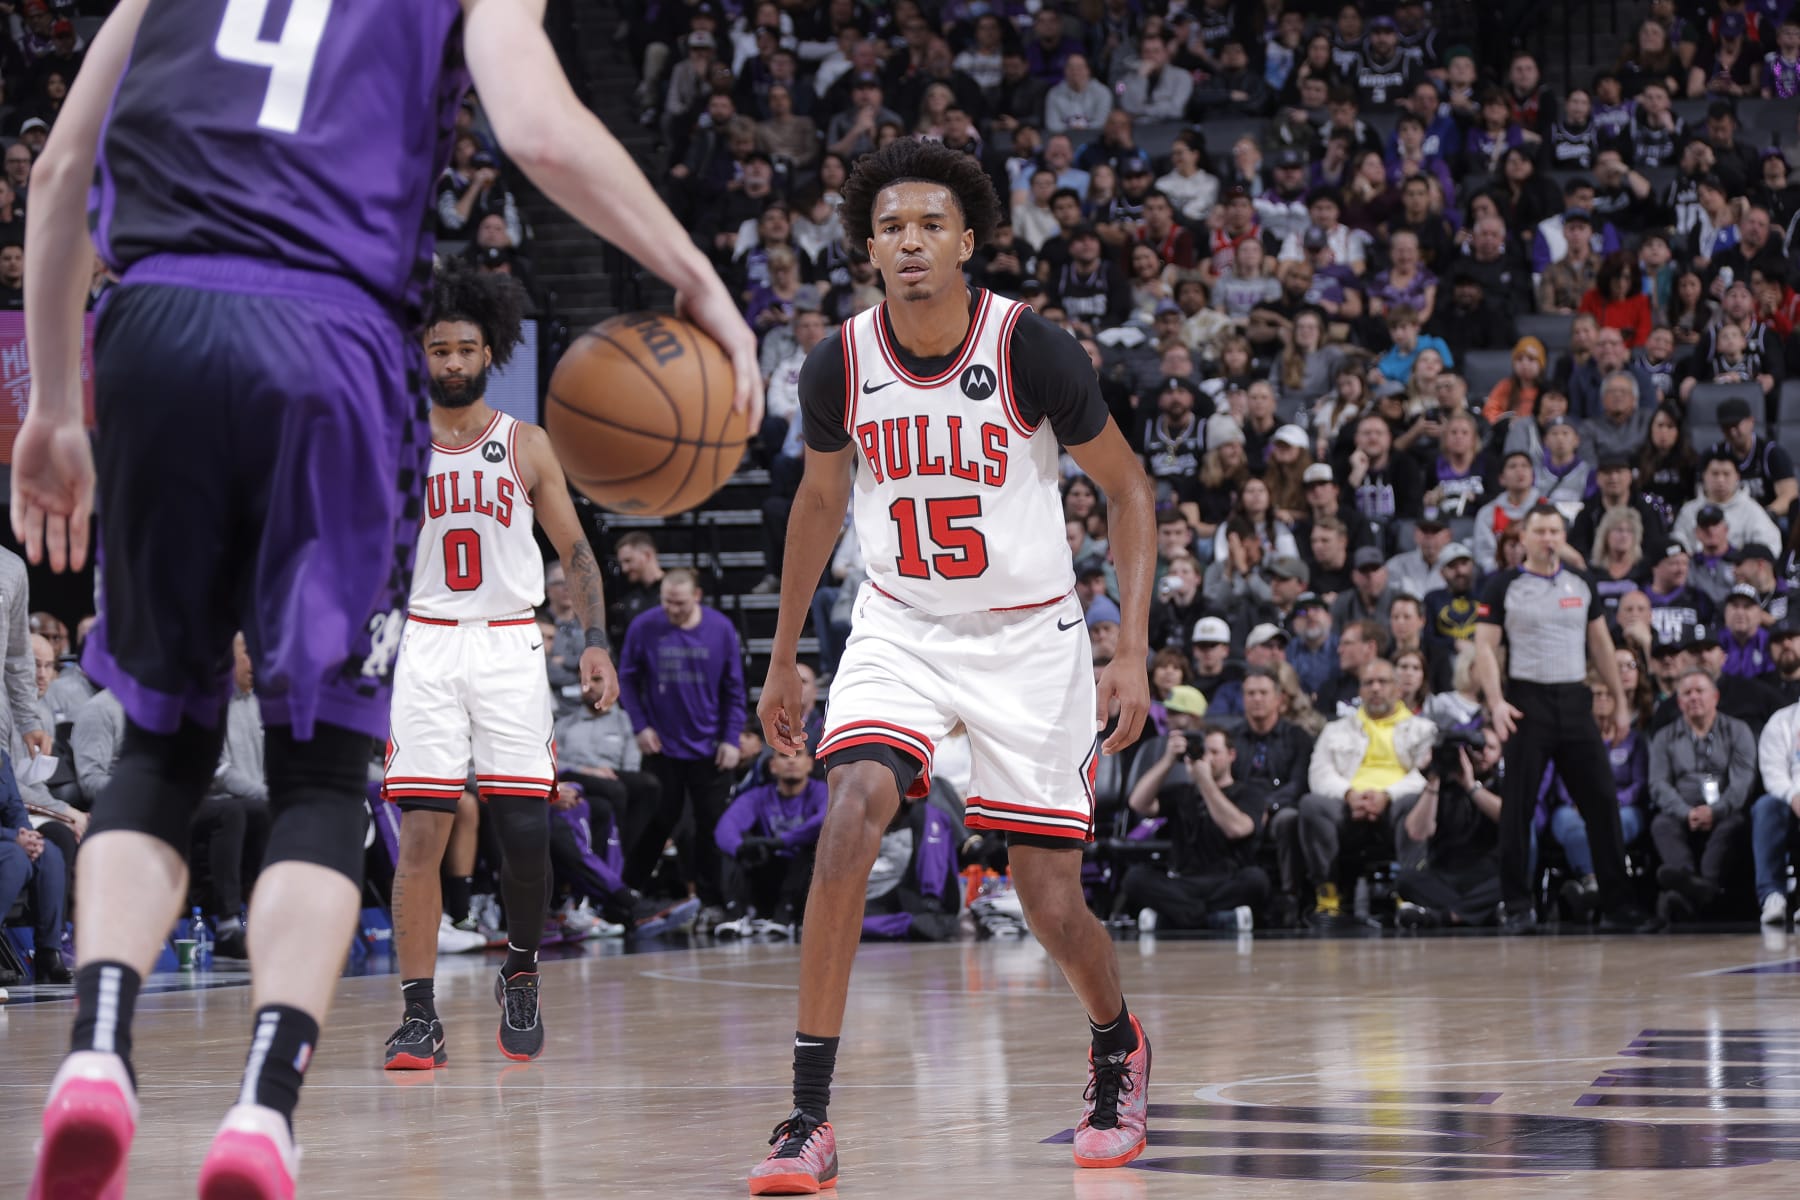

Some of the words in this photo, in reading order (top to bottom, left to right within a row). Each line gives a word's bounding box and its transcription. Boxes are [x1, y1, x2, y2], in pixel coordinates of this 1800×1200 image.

[214, 0, 333, 134] 4
[856, 415, 1008, 488] BULLS
[425, 470, 514, 528] ULLS
[442, 527, 482, 592] 0
[889, 495, 989, 580] 15
